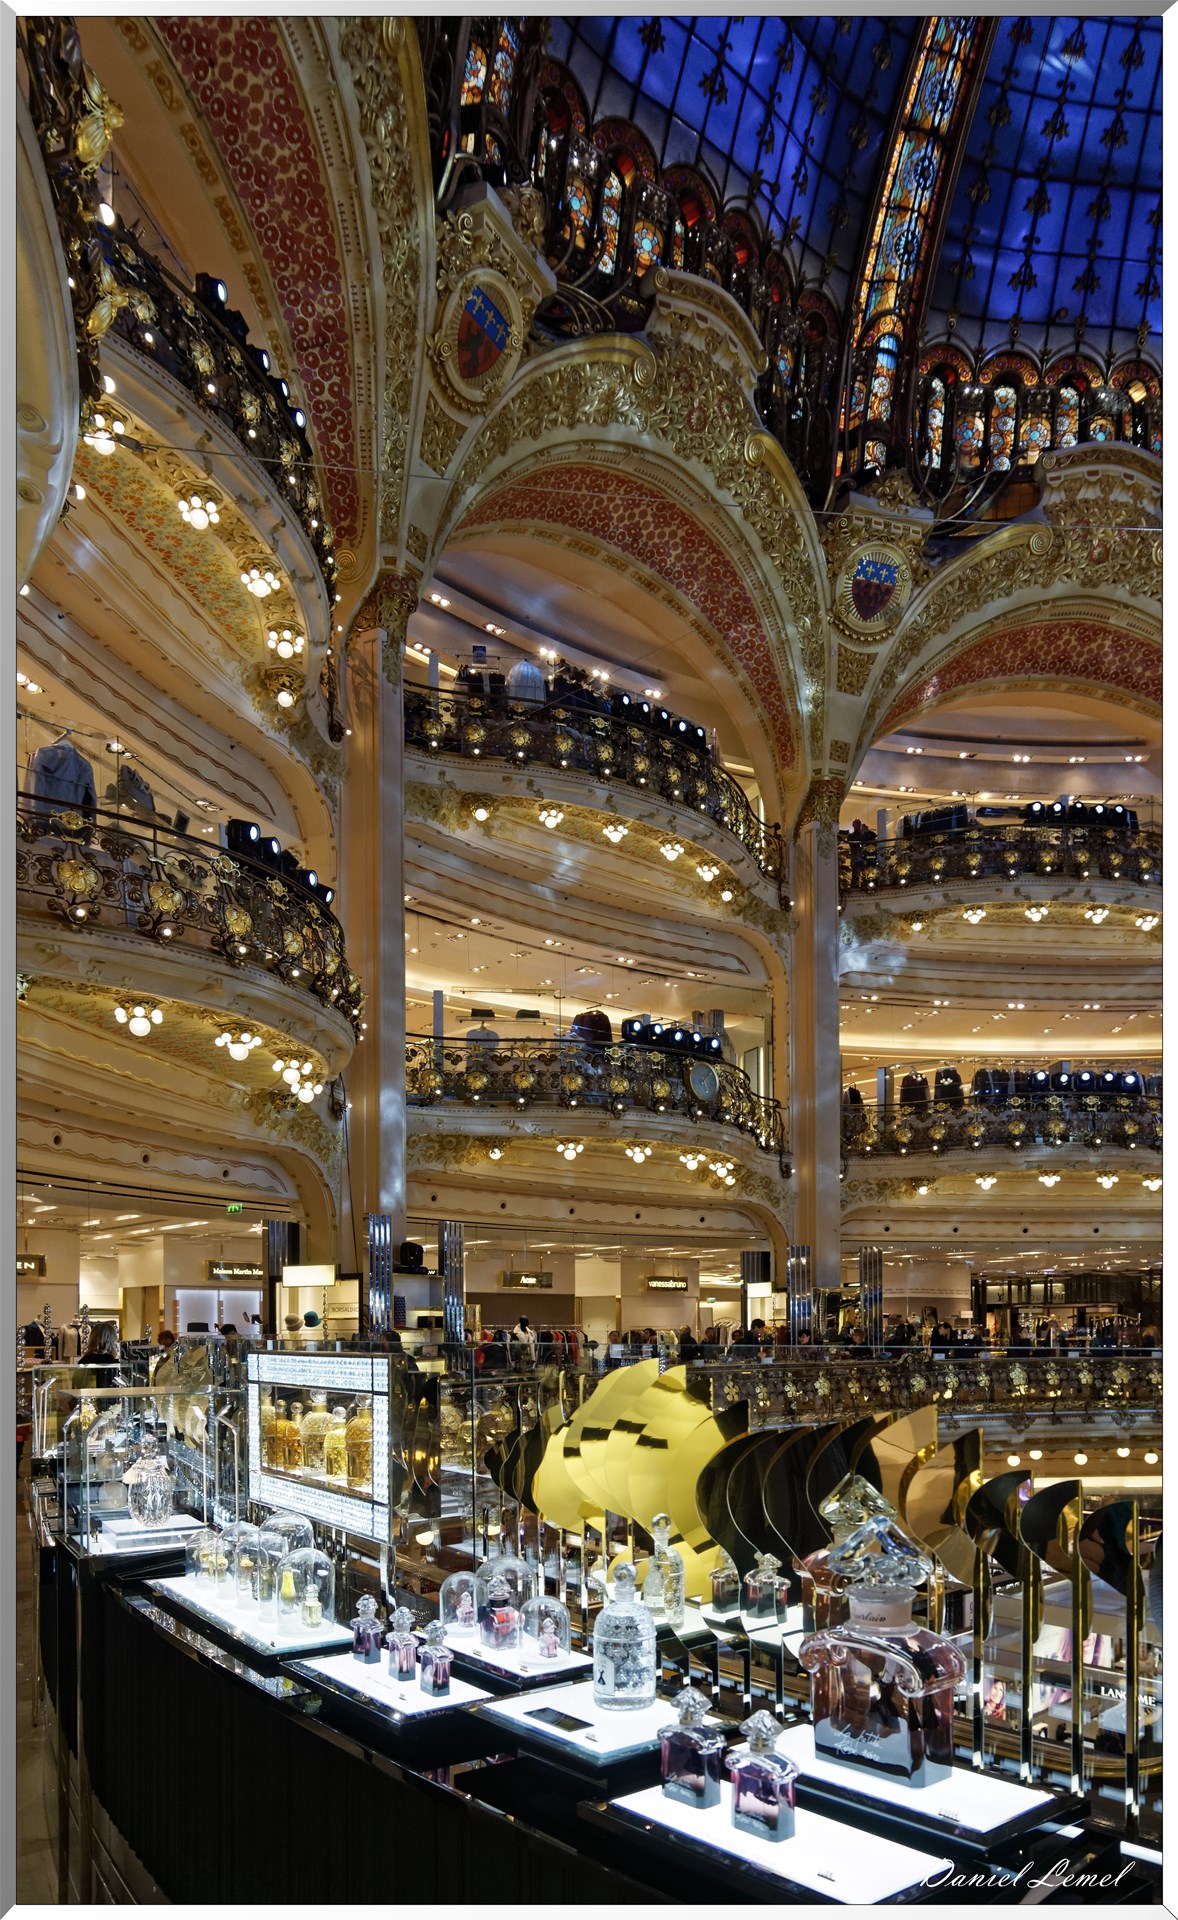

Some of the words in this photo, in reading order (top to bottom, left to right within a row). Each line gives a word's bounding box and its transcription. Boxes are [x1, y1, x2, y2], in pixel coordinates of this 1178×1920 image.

[16, 1261, 35, 1270] EN
[213, 1267, 232, 1275] Maison
[233, 1267, 252, 1275] Martin
[648, 1280, 687, 1288] vanessabruno
[1100, 1686, 1156, 1707] LANCME
